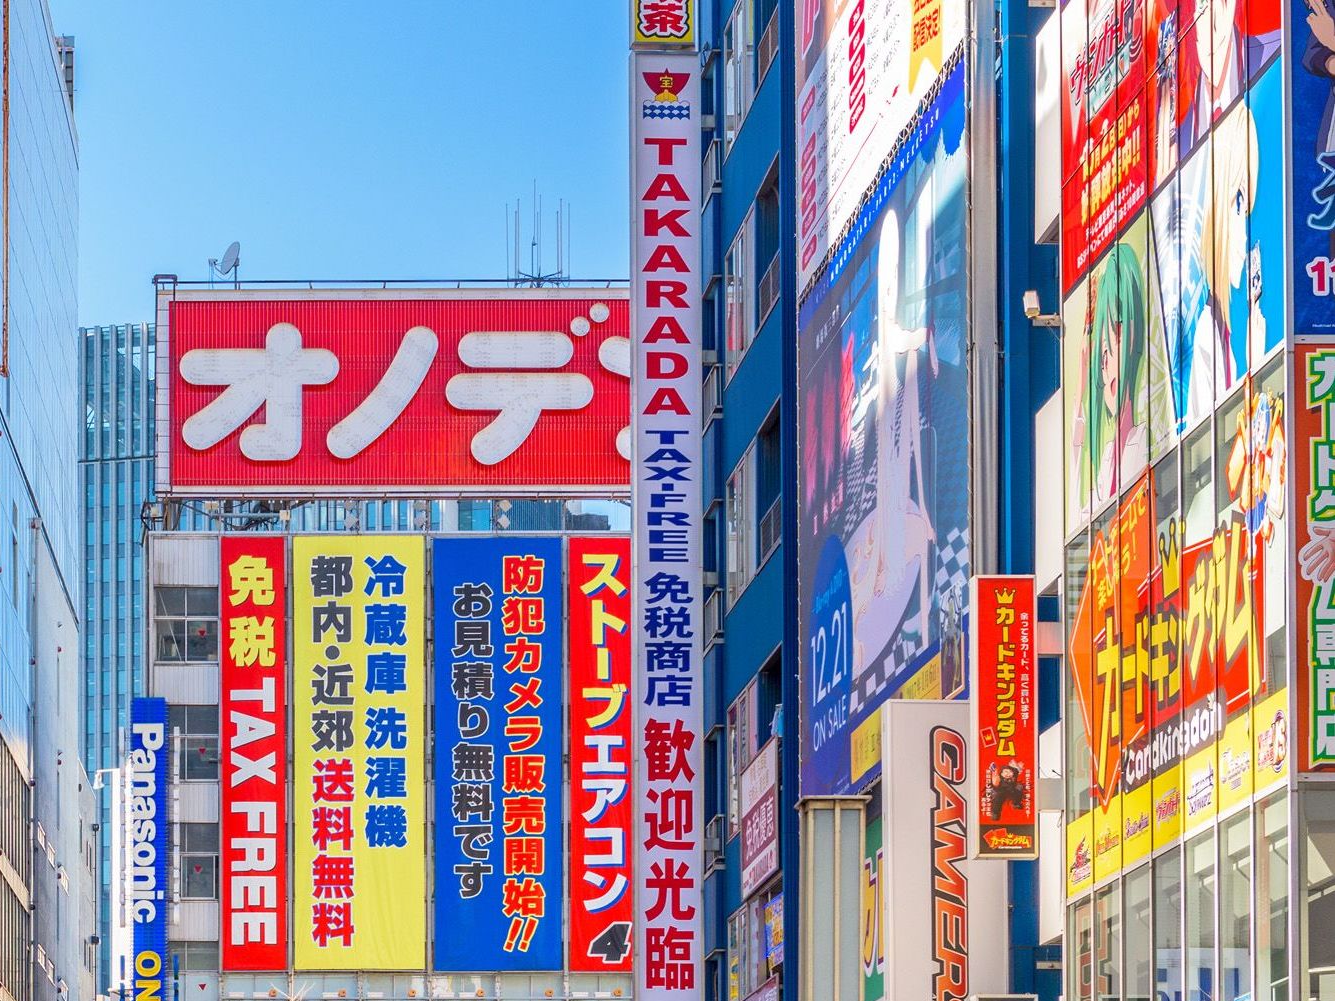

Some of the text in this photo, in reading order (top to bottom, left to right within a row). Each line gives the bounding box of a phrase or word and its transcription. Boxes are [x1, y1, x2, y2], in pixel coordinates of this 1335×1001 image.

[178, 302, 631, 466] オノデ
[642, 138, 693, 564] TAKARADA TAX-FREE
[228, 554, 276, 669] 免税
[364, 555, 408, 849] 冷蔵庫 洗濯機
[812, 601, 847, 707] 12.21
[813, 692, 847, 752] ON SALE
[996, 607, 1016, 756] カードキングダム
[132, 722, 164, 924] Panasonic
[229, 677, 278, 947] TAX FREE
[452, 582, 495, 899] お見積り無料です
[502, 555, 546, 953] 防犯カメラ販売開始!!
[643, 571, 696, 991] 免税商店 歓迎光臨
